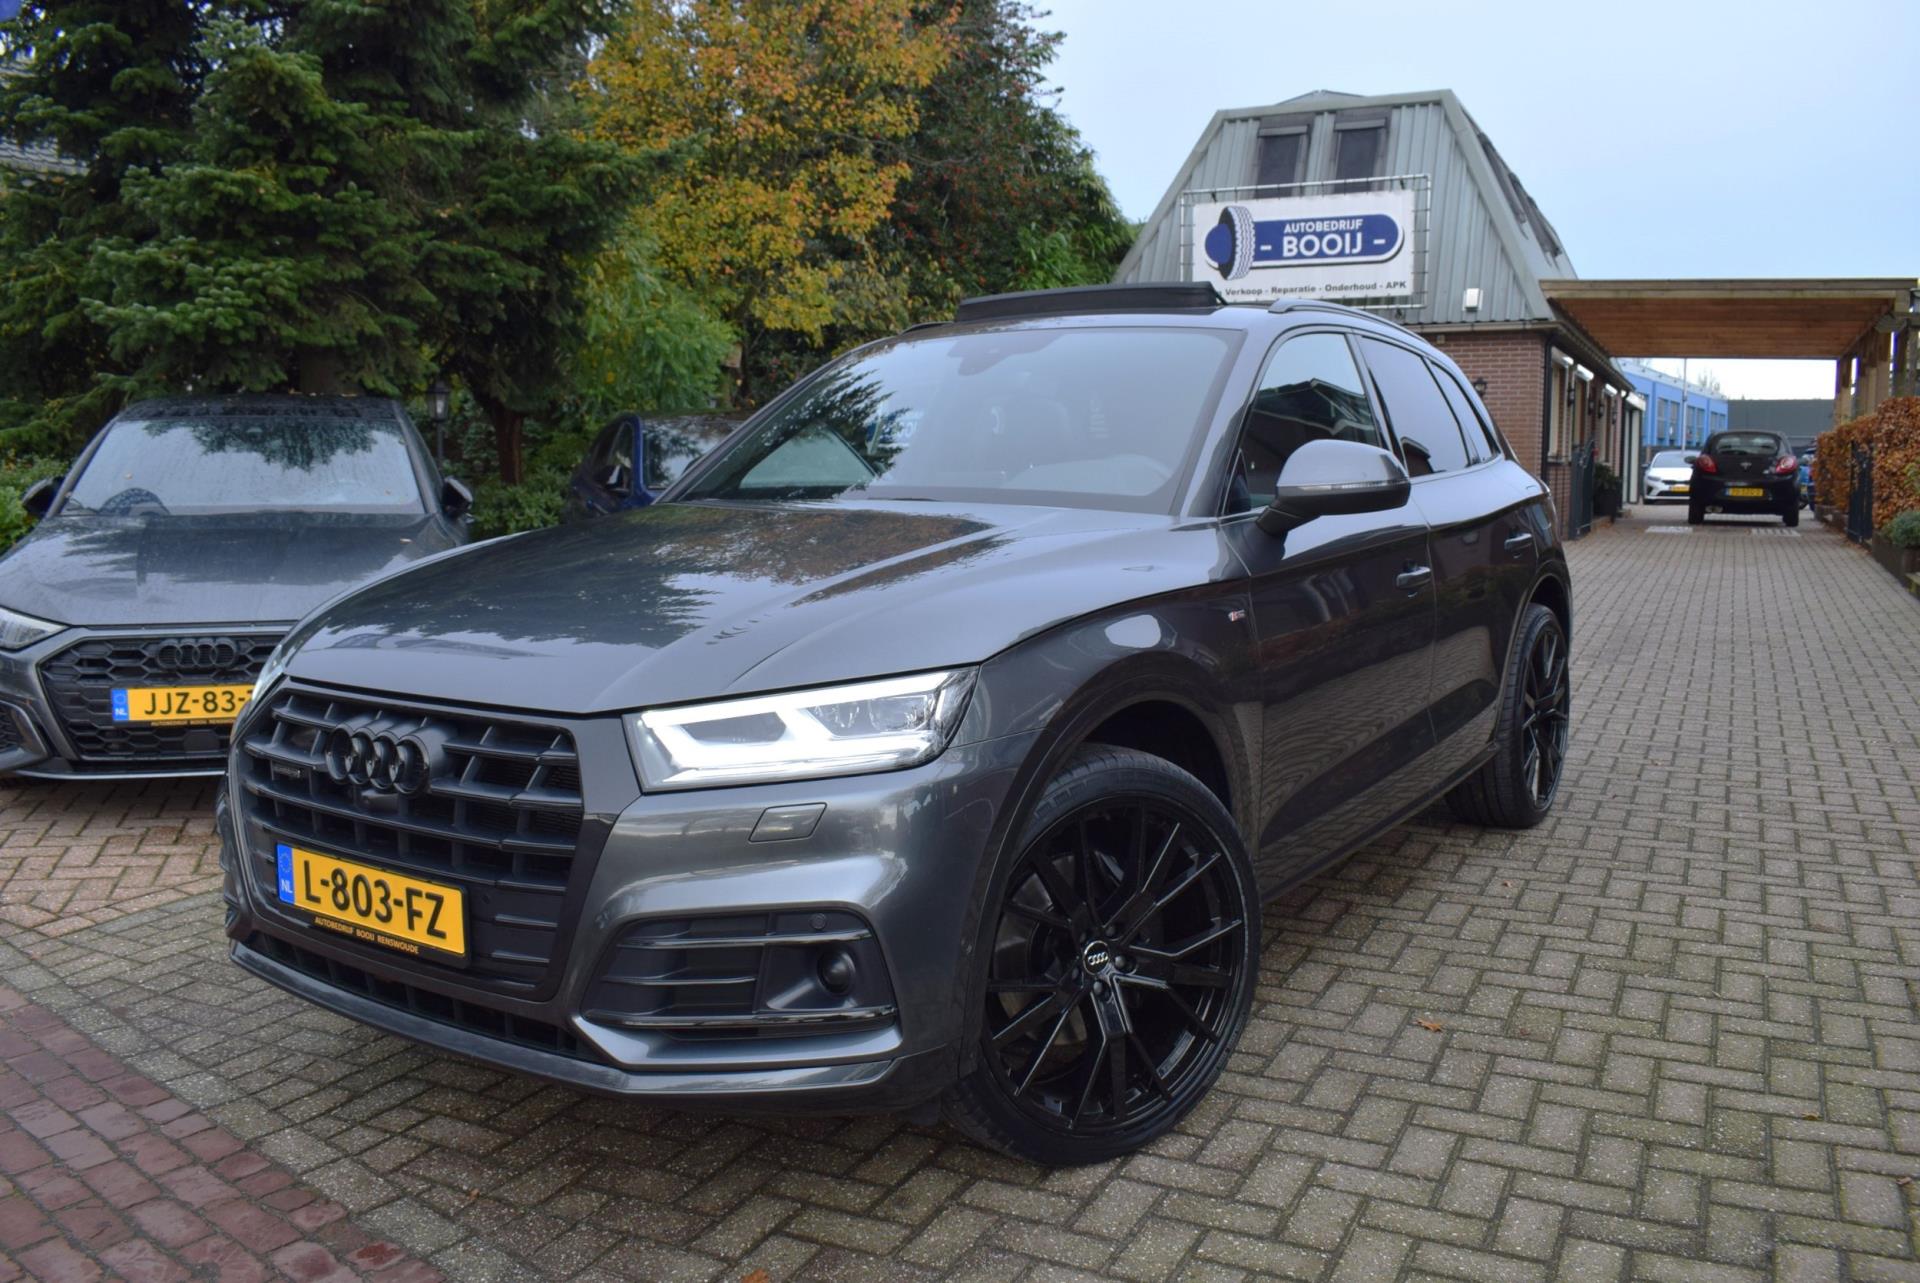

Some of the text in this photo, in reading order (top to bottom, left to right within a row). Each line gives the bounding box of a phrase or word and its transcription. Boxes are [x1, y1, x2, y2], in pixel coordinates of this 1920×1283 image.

[1283, 219, 1364, 234] AUTOBEDRIJF
[1282, 231, 1362, 257] BOOIJ
[1225, 288, 1262, 297] Verkoop
[1271, 285, 1316, 295] Reparatie
[1324, 282, 1377, 293] Onderhoud
[1385, 281, 1407, 290] APK
[281, 878, 293, 894] NL
[303, 859, 447, 940] L-803-FZ
